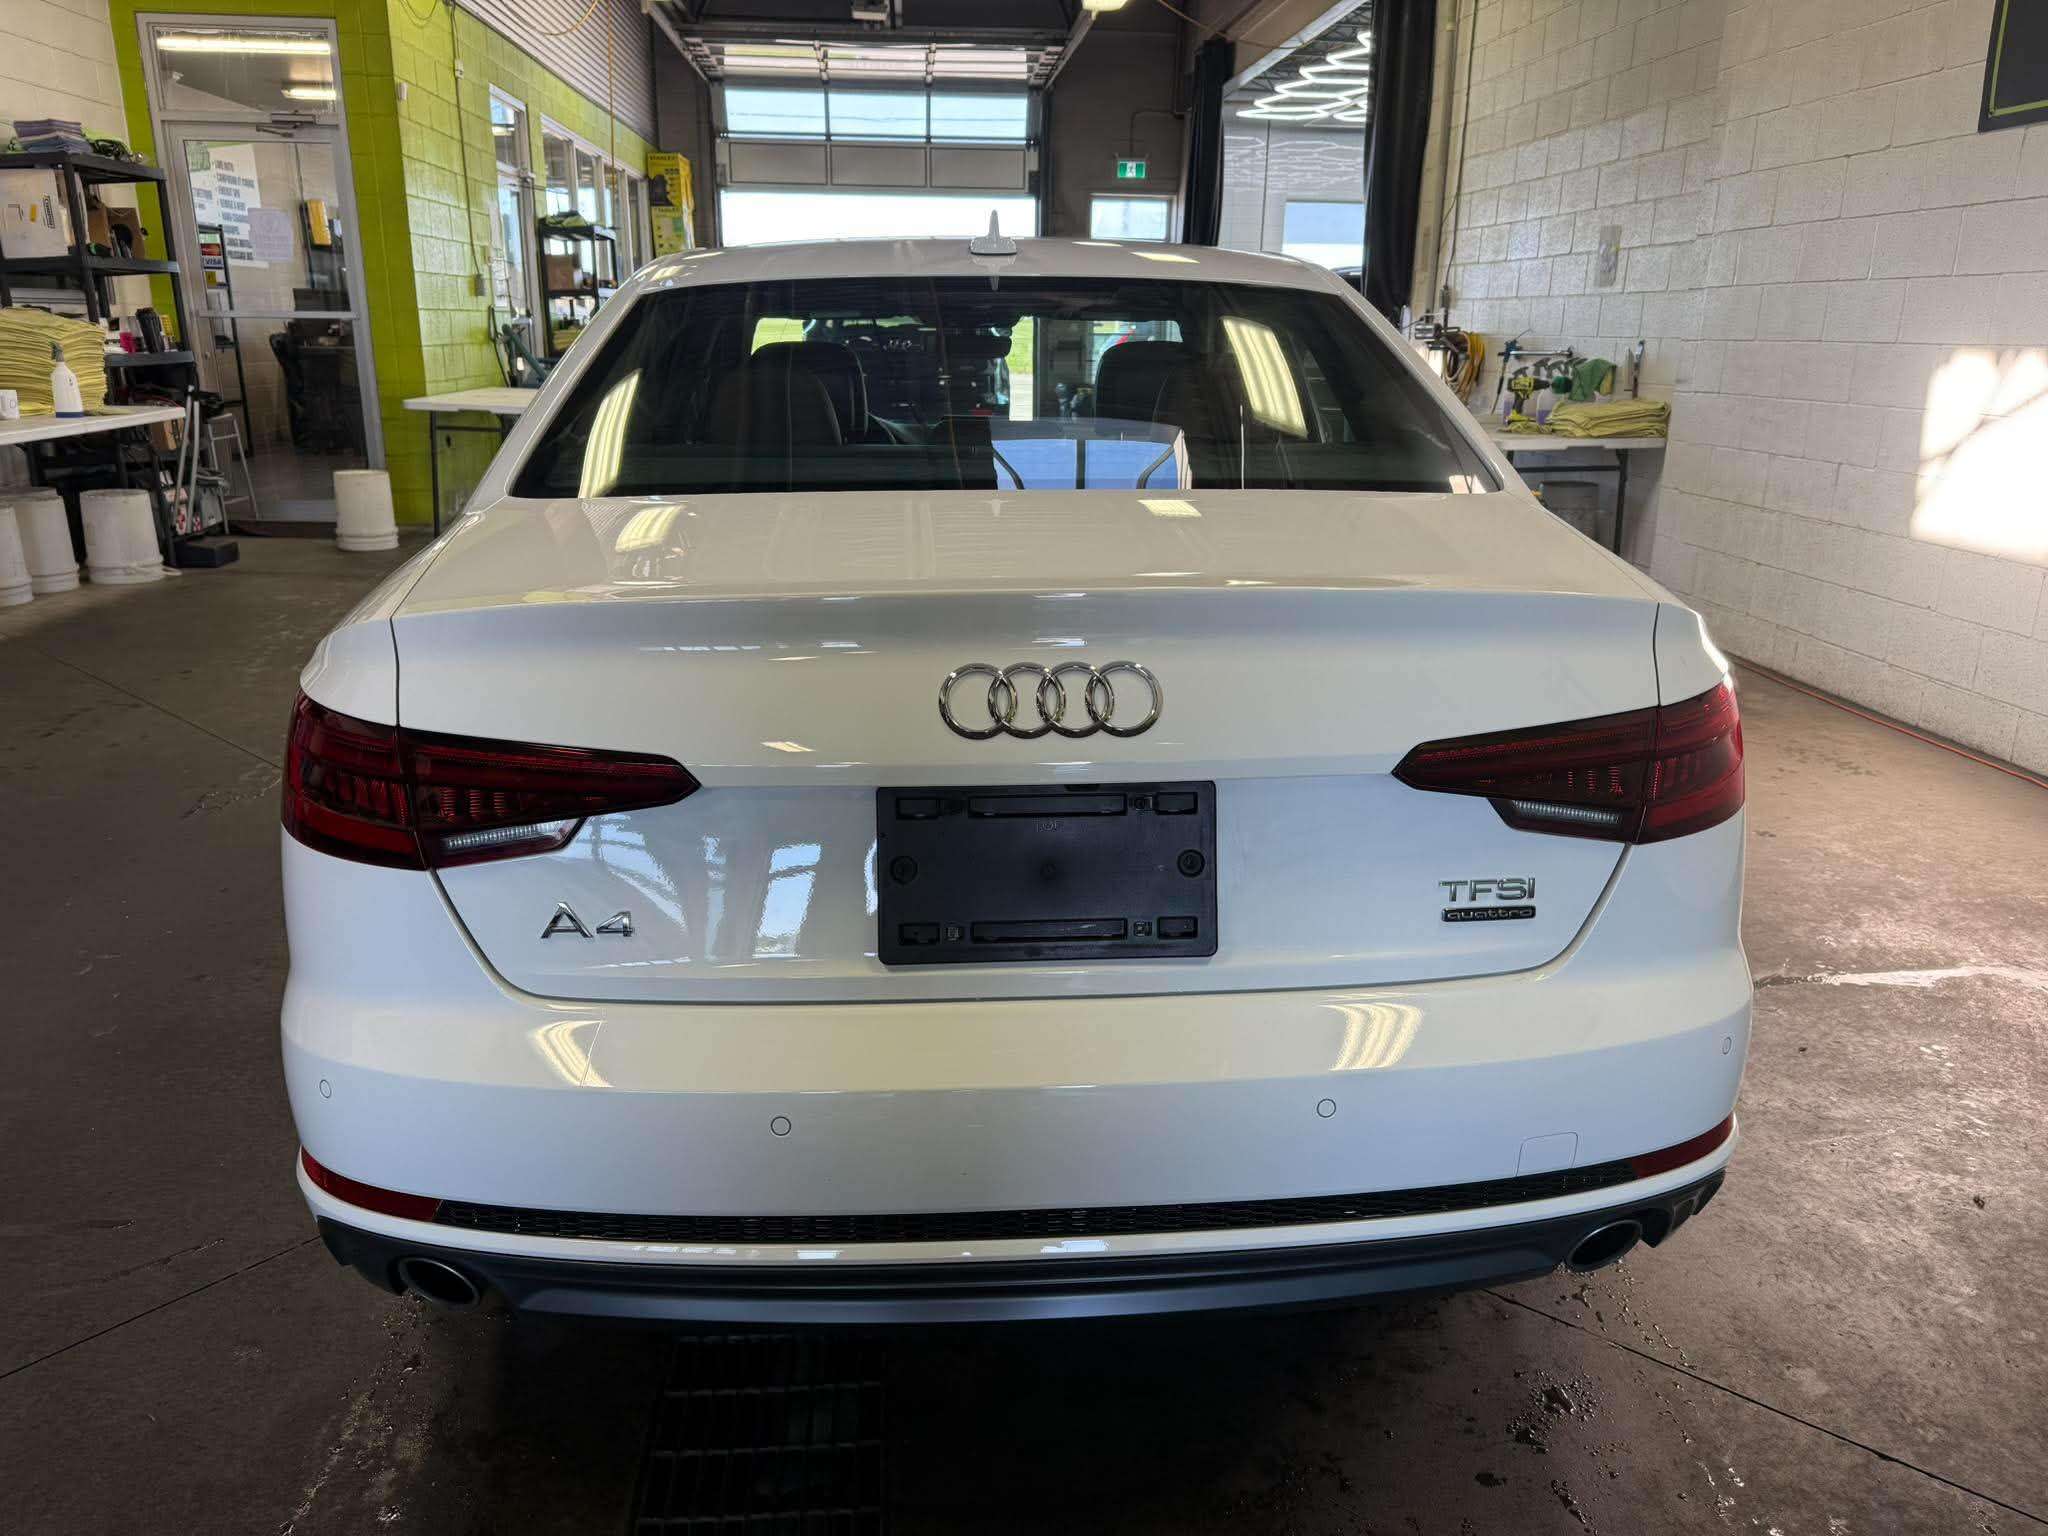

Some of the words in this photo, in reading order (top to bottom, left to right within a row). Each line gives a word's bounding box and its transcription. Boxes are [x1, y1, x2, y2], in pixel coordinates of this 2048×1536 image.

[1439, 877, 1536, 902] TFSI
[540, 901, 635, 939] A4
[1446, 908, 1533, 921] quattro
